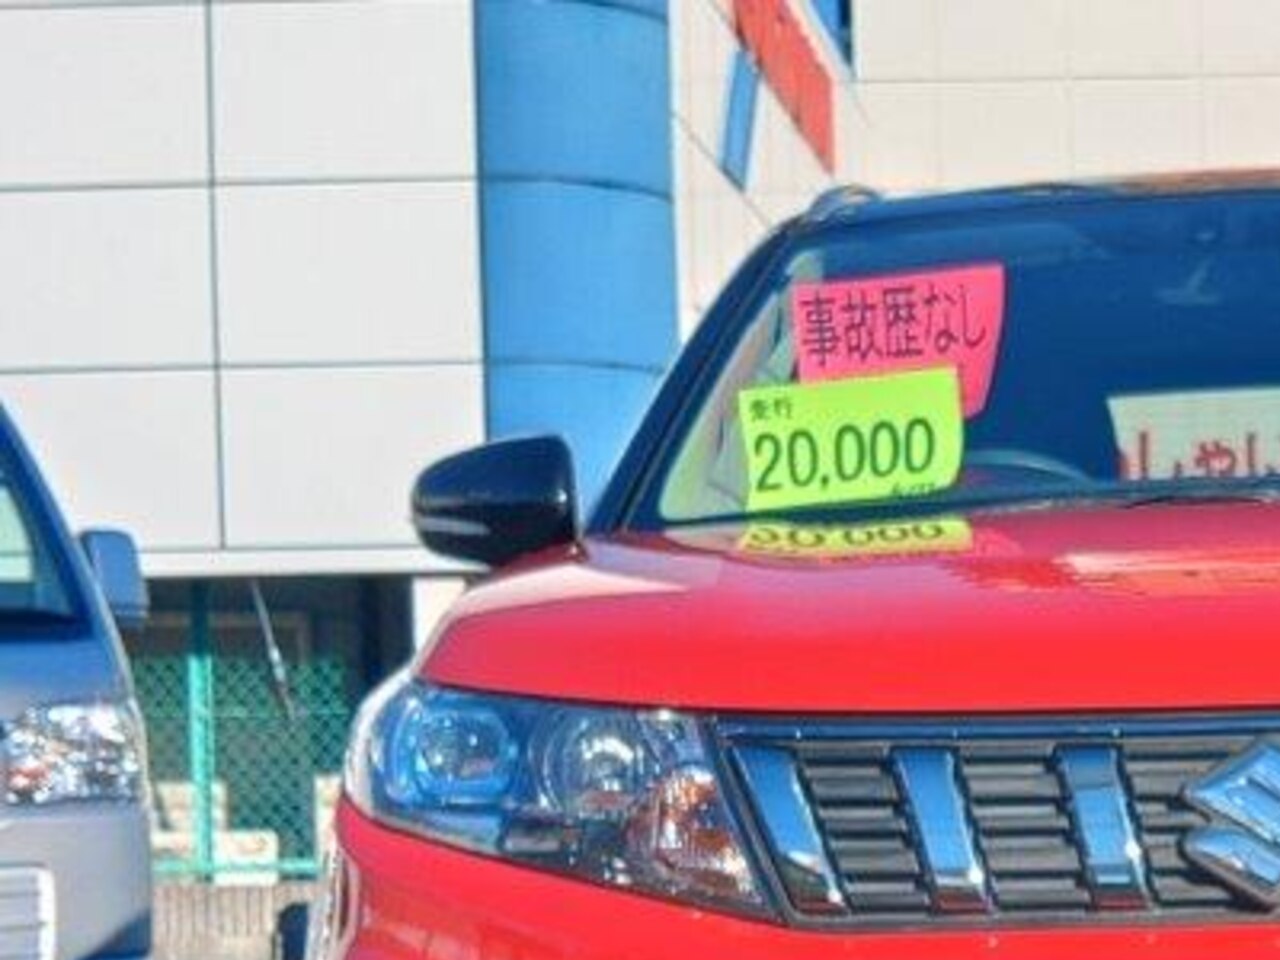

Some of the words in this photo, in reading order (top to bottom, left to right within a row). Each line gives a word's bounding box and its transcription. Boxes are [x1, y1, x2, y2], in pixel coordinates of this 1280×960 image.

[800, 284, 987, 366] 事故歴なし
[754, 417, 936, 493] 20,000
